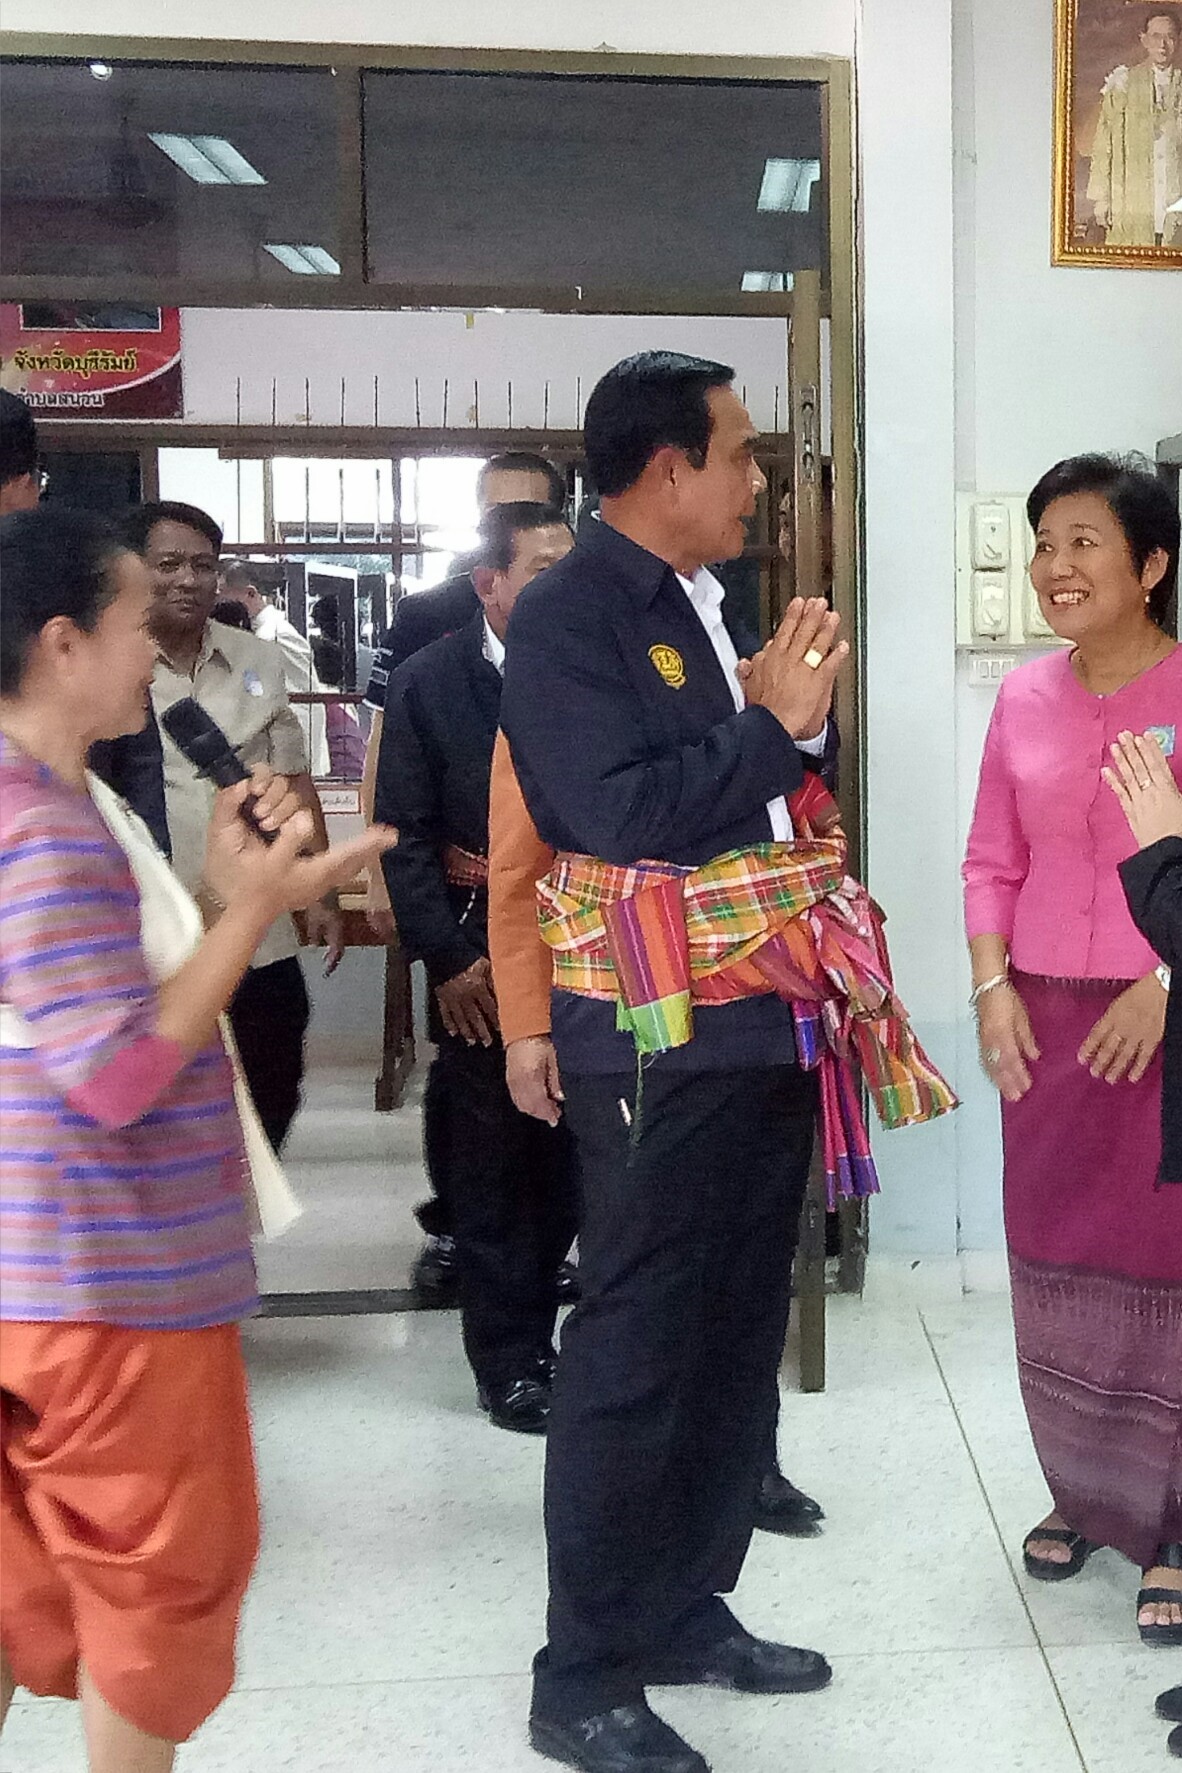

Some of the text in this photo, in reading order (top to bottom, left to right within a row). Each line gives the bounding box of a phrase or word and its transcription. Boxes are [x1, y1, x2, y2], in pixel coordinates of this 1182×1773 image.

[14, 348, 138, 379] จังหวัดบุรีรัมย์
